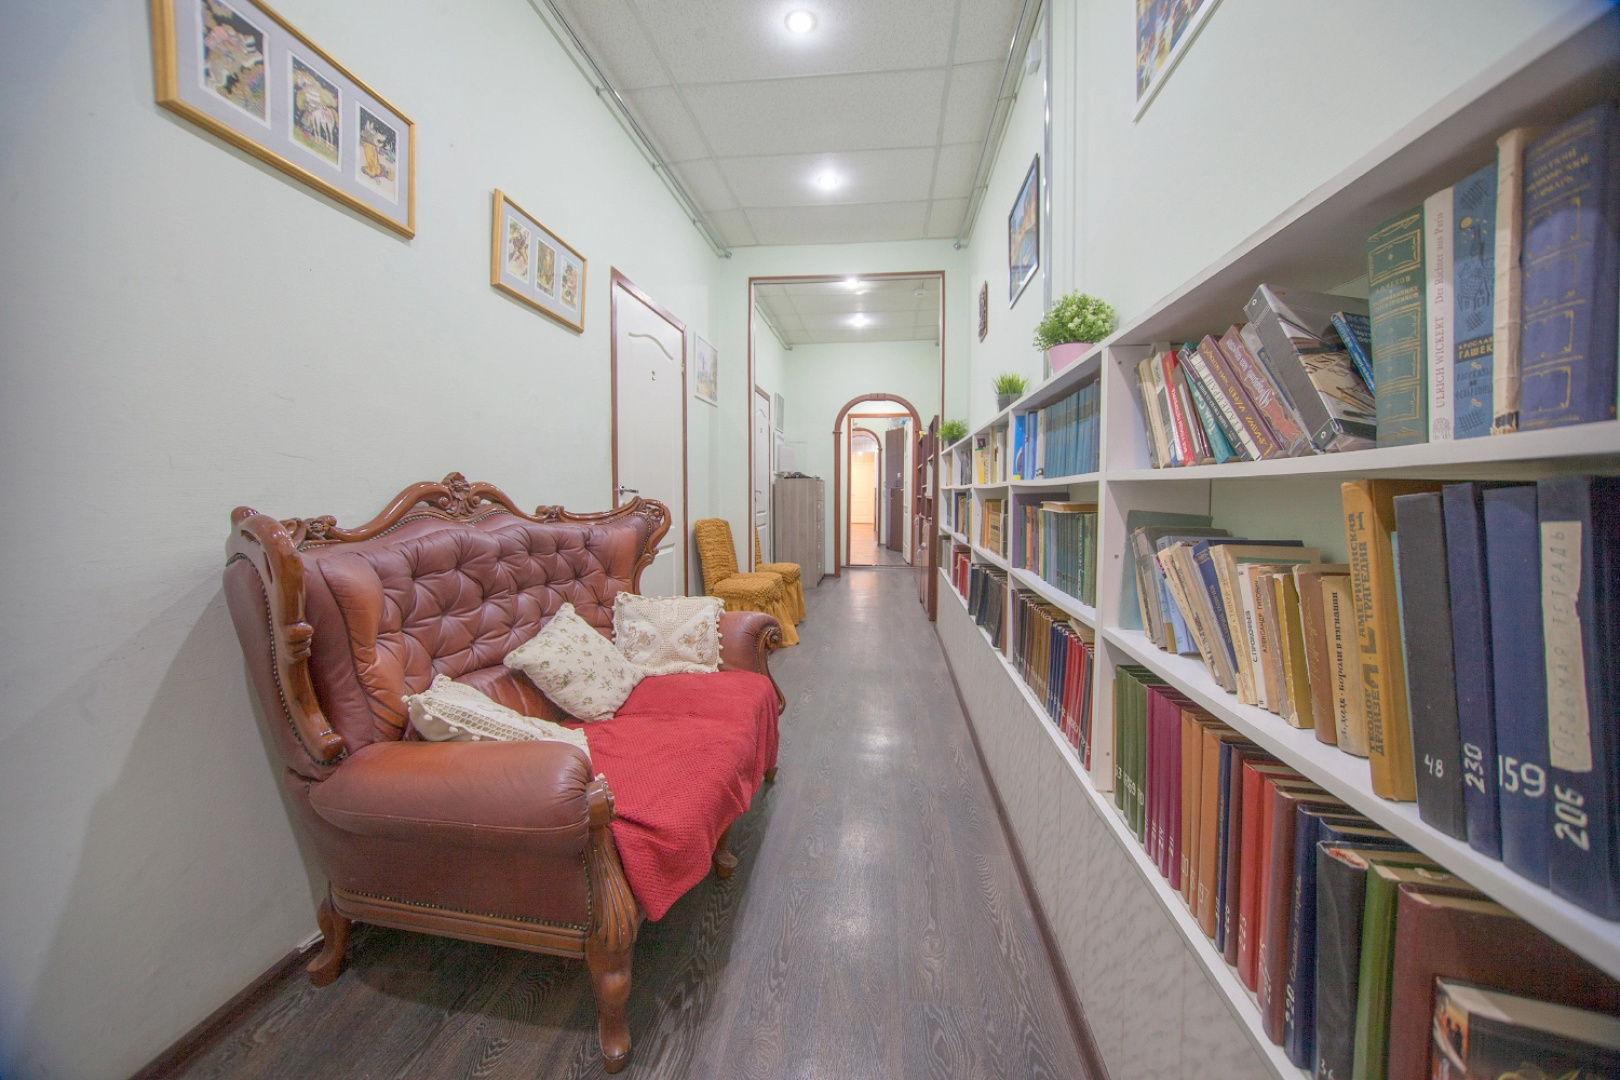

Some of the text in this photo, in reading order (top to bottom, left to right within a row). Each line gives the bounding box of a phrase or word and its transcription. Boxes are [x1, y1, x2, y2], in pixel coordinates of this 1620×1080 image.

[1434, 212, 1444, 235] Paris
[1434, 254, 1444, 285] Richter
[1434, 288, 1444, 304] Der
[1435, 317, 1445, 365] WICKERT
[1458, 344, 1493, 359] ГАШЕК
[1436, 367, 1445, 409] ULRICH
[1348, 513, 1366, 638] АМЕРИКАНСКАЯ
[1358, 541, 1373, 622] ТРАГЕДИЯ
[1550, 530, 1569, 625] ТЕТРАДЬ
[1258, 613, 1268, 653] АЛЕКСАНДР
[1365, 688, 1377, 752] ТЕОДОР
[1424, 754, 1444, 779] 48
[1463, 742, 1485, 795] 230
[1498, 754, 1547, 797] 159
[1554, 783, 1590, 851] 206
